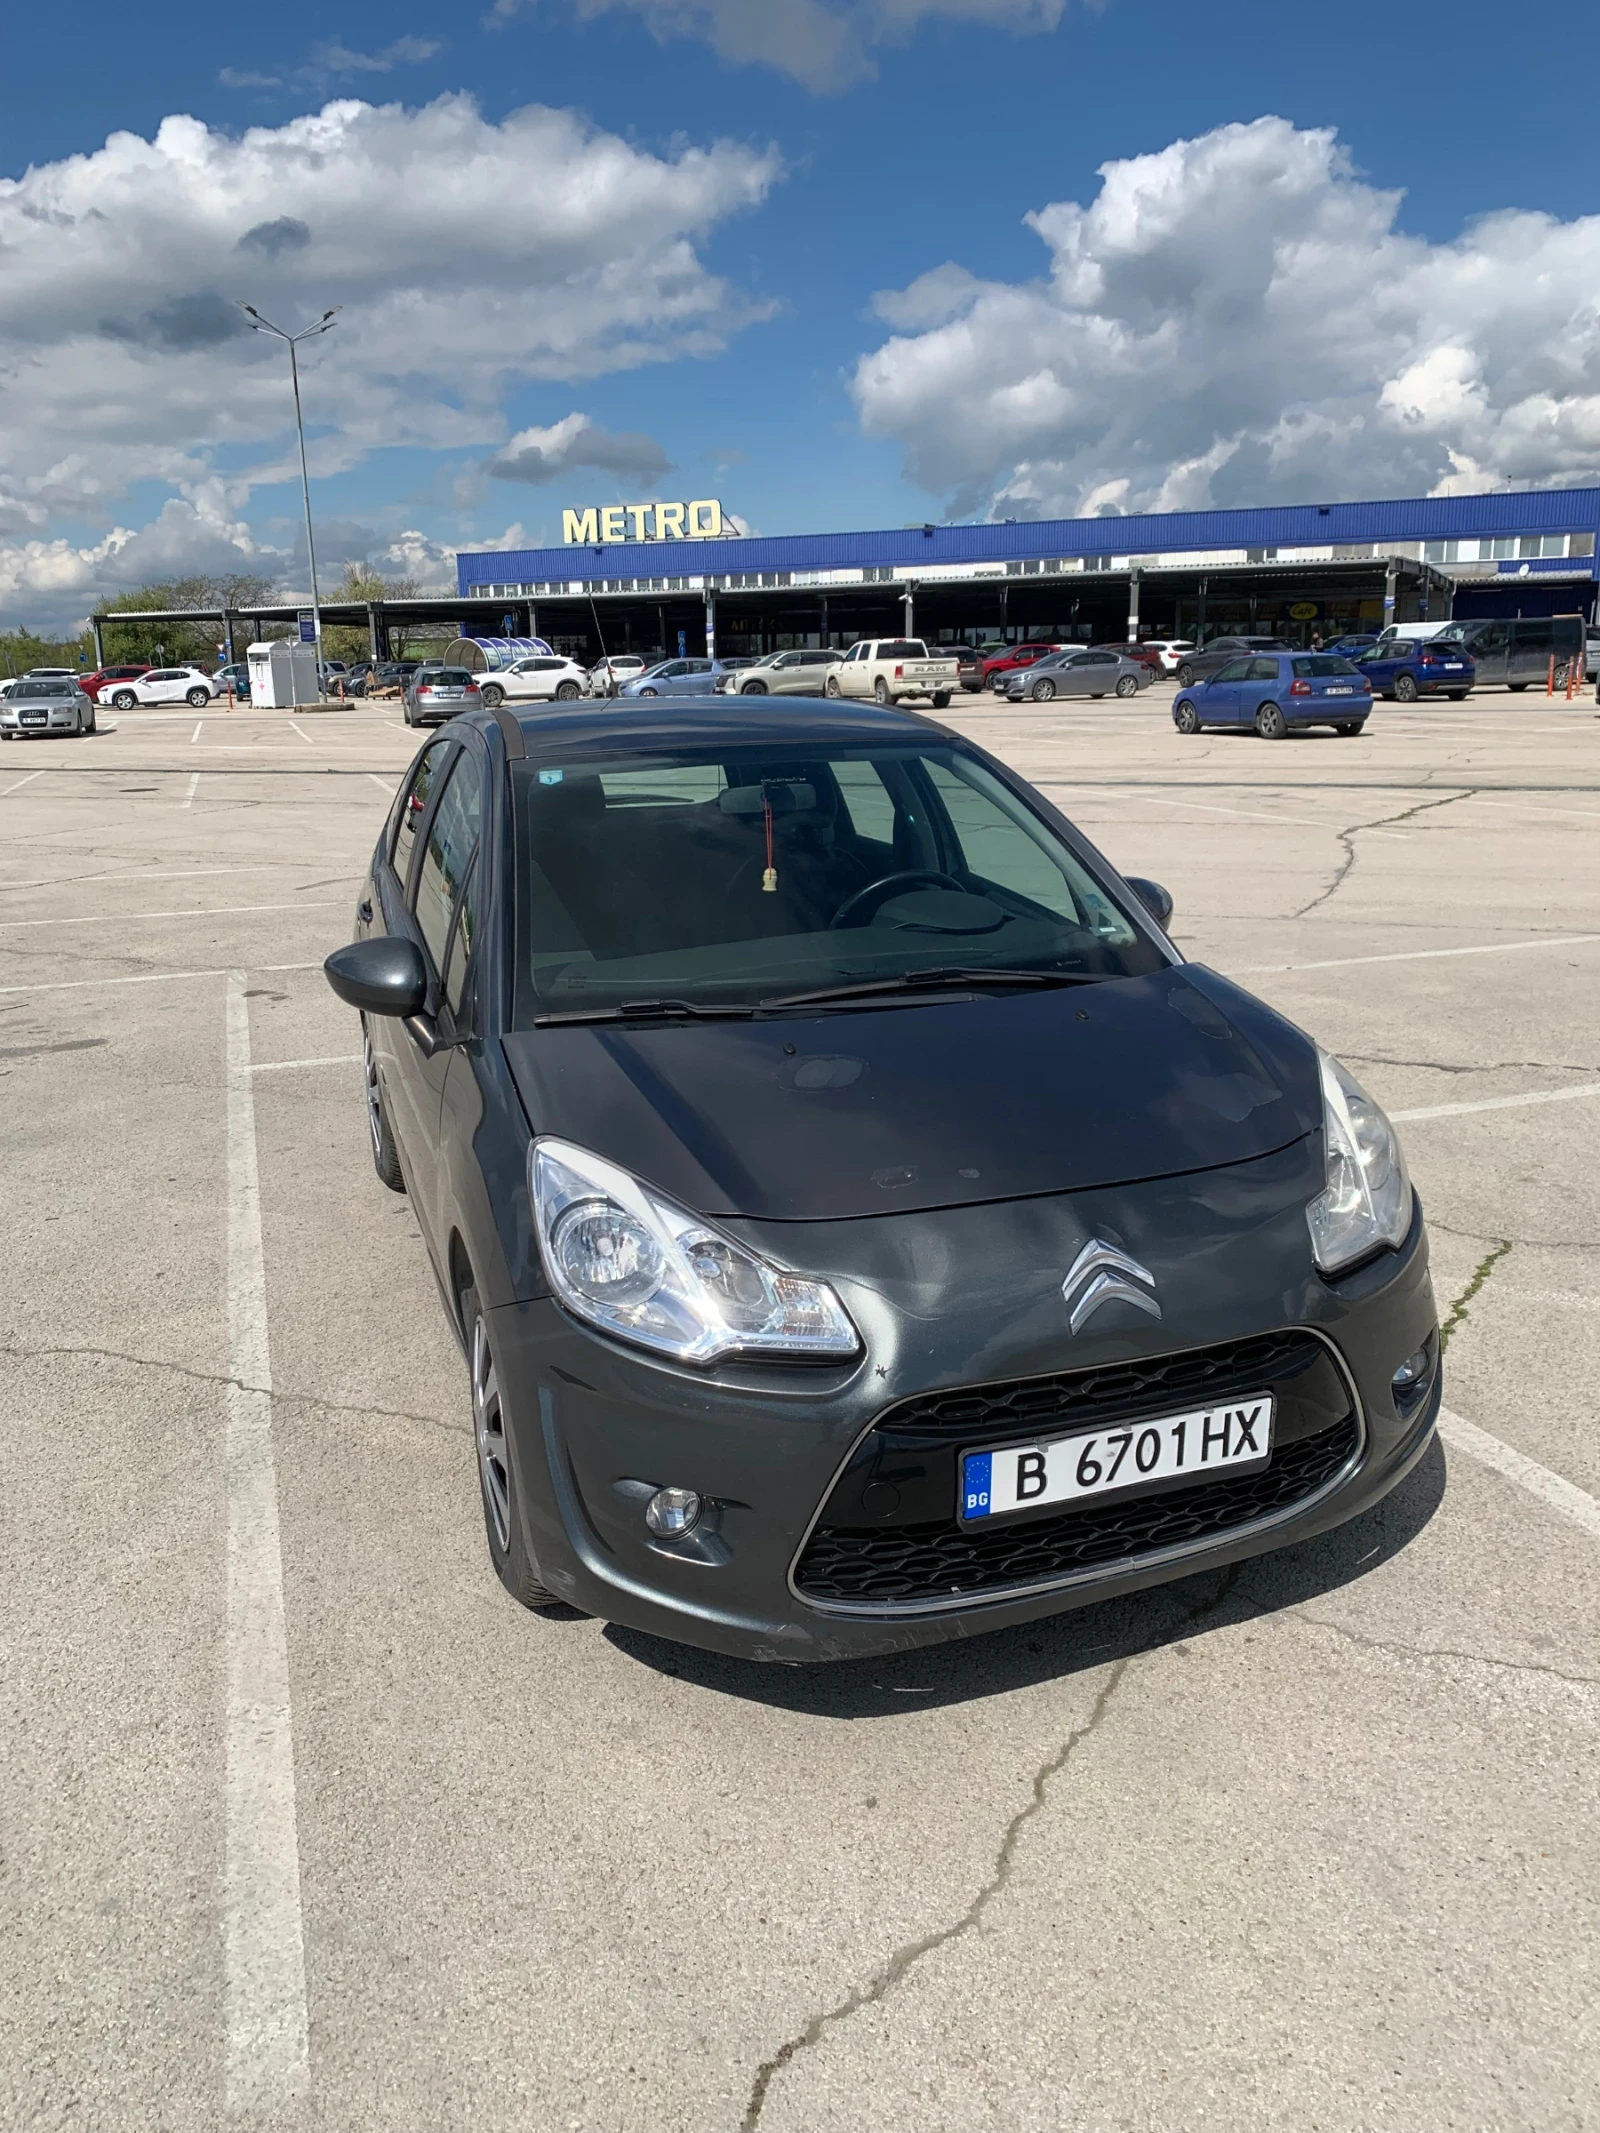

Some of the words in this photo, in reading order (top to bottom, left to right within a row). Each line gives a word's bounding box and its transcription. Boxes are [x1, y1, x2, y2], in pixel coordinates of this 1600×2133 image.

[562, 499, 722, 544] METRO
[914, 665, 947, 673] RAM
[1015, 1451, 1049, 1502] B
[1075, 1421, 1187, 1487] 6701
[1200, 1406, 1263, 1462] HX
[967, 1491, 988, 1509] BG
